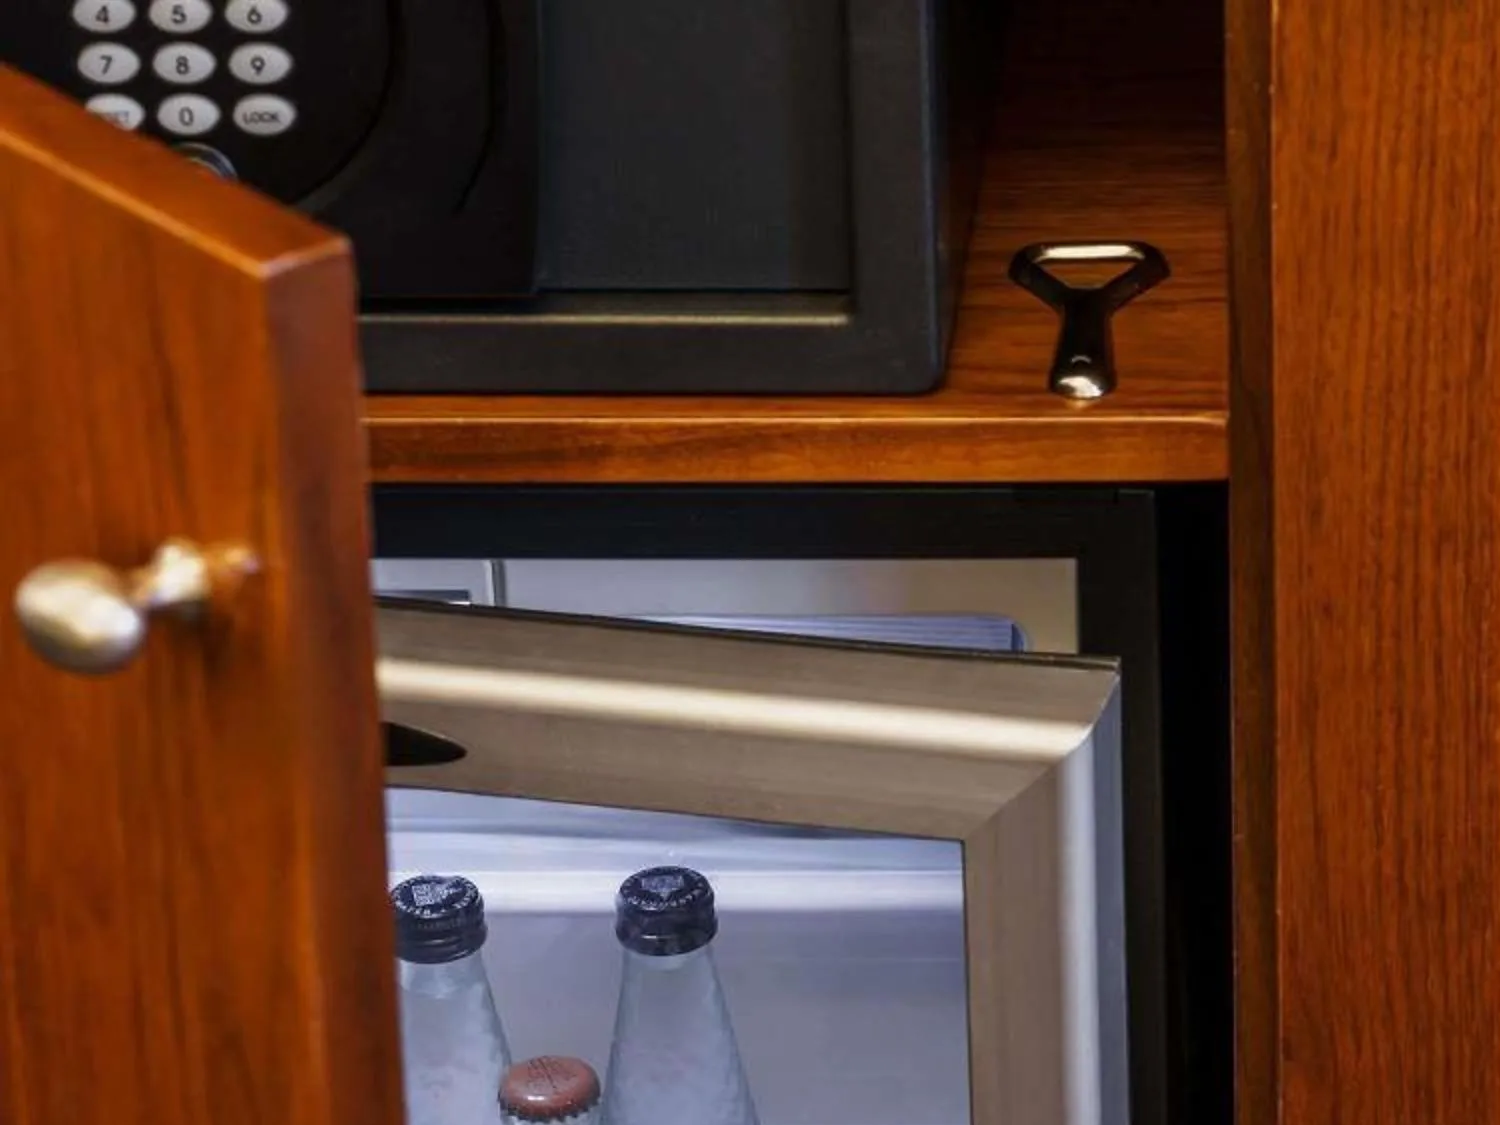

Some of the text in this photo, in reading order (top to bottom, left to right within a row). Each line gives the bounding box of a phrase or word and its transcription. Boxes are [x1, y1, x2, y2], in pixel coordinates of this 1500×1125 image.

[95, 5, 109, 24] 4
[171, 5, 187, 24] 5
[246, 6, 262, 24] 6
[100, 55, 113, 75] 7
[175, 55, 190, 76] 8
[250, 56, 265, 75] 9
[178, 107, 194, 126] 0
[243, 111, 281, 125] LOCK
